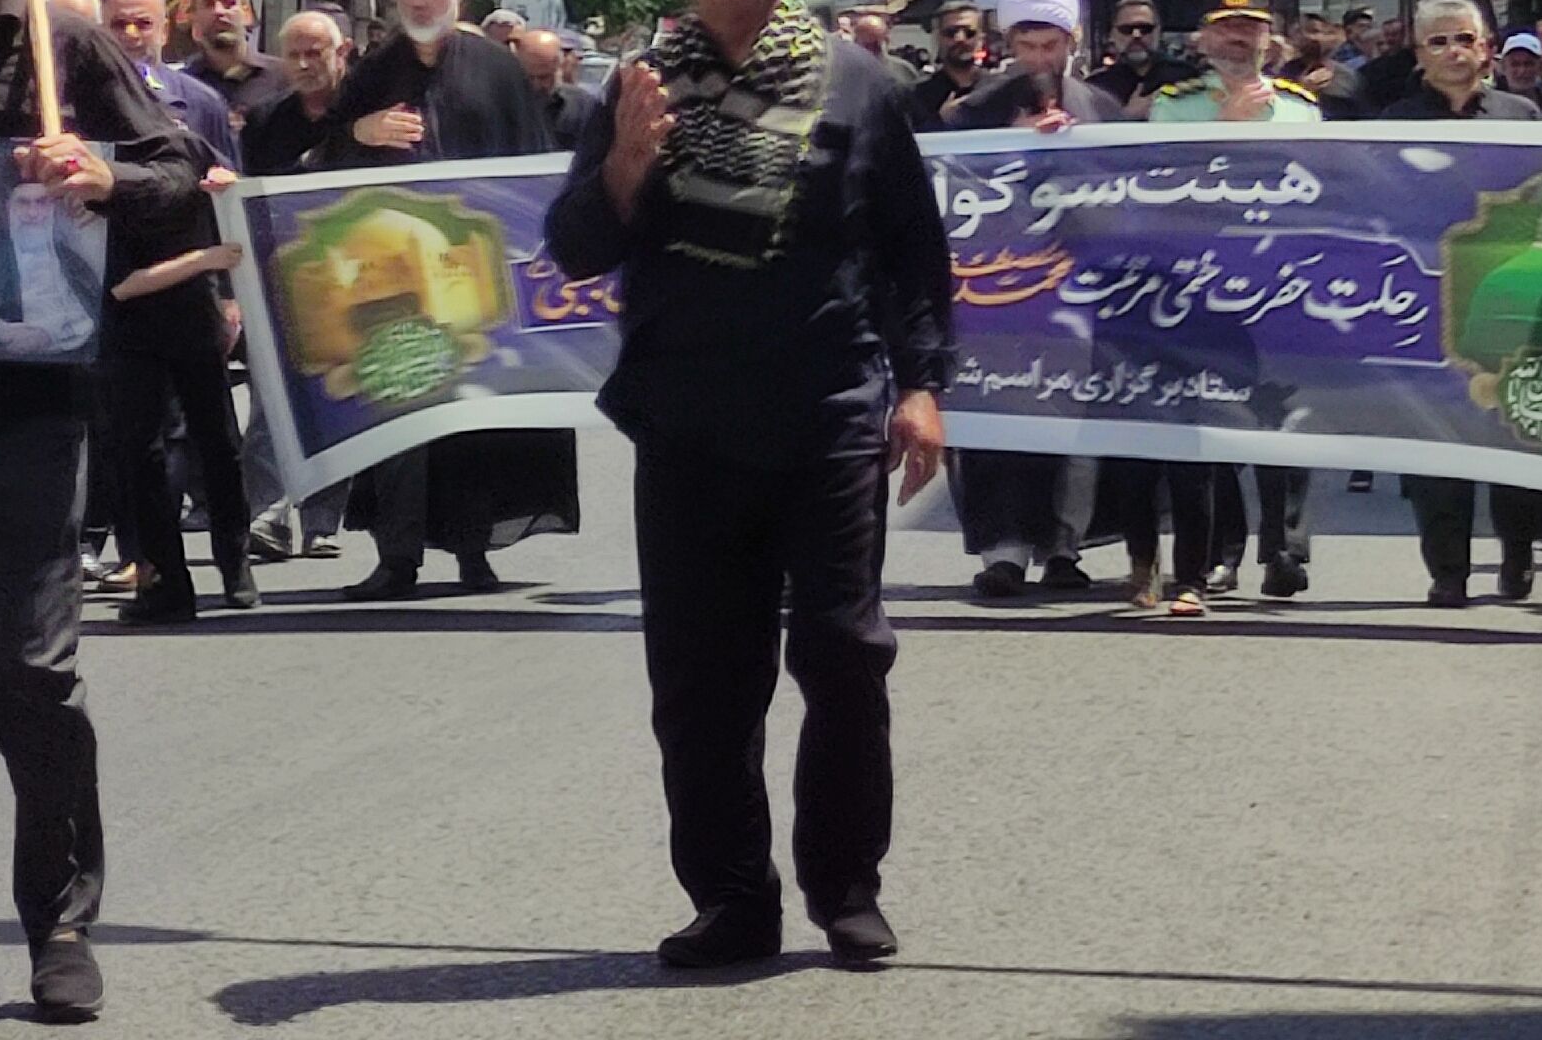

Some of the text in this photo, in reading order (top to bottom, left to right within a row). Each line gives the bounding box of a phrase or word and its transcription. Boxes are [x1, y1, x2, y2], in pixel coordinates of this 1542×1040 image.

[933, 157, 1321, 238] هیئت سوگوا
[983, 358, 1073, 400] مراسم
